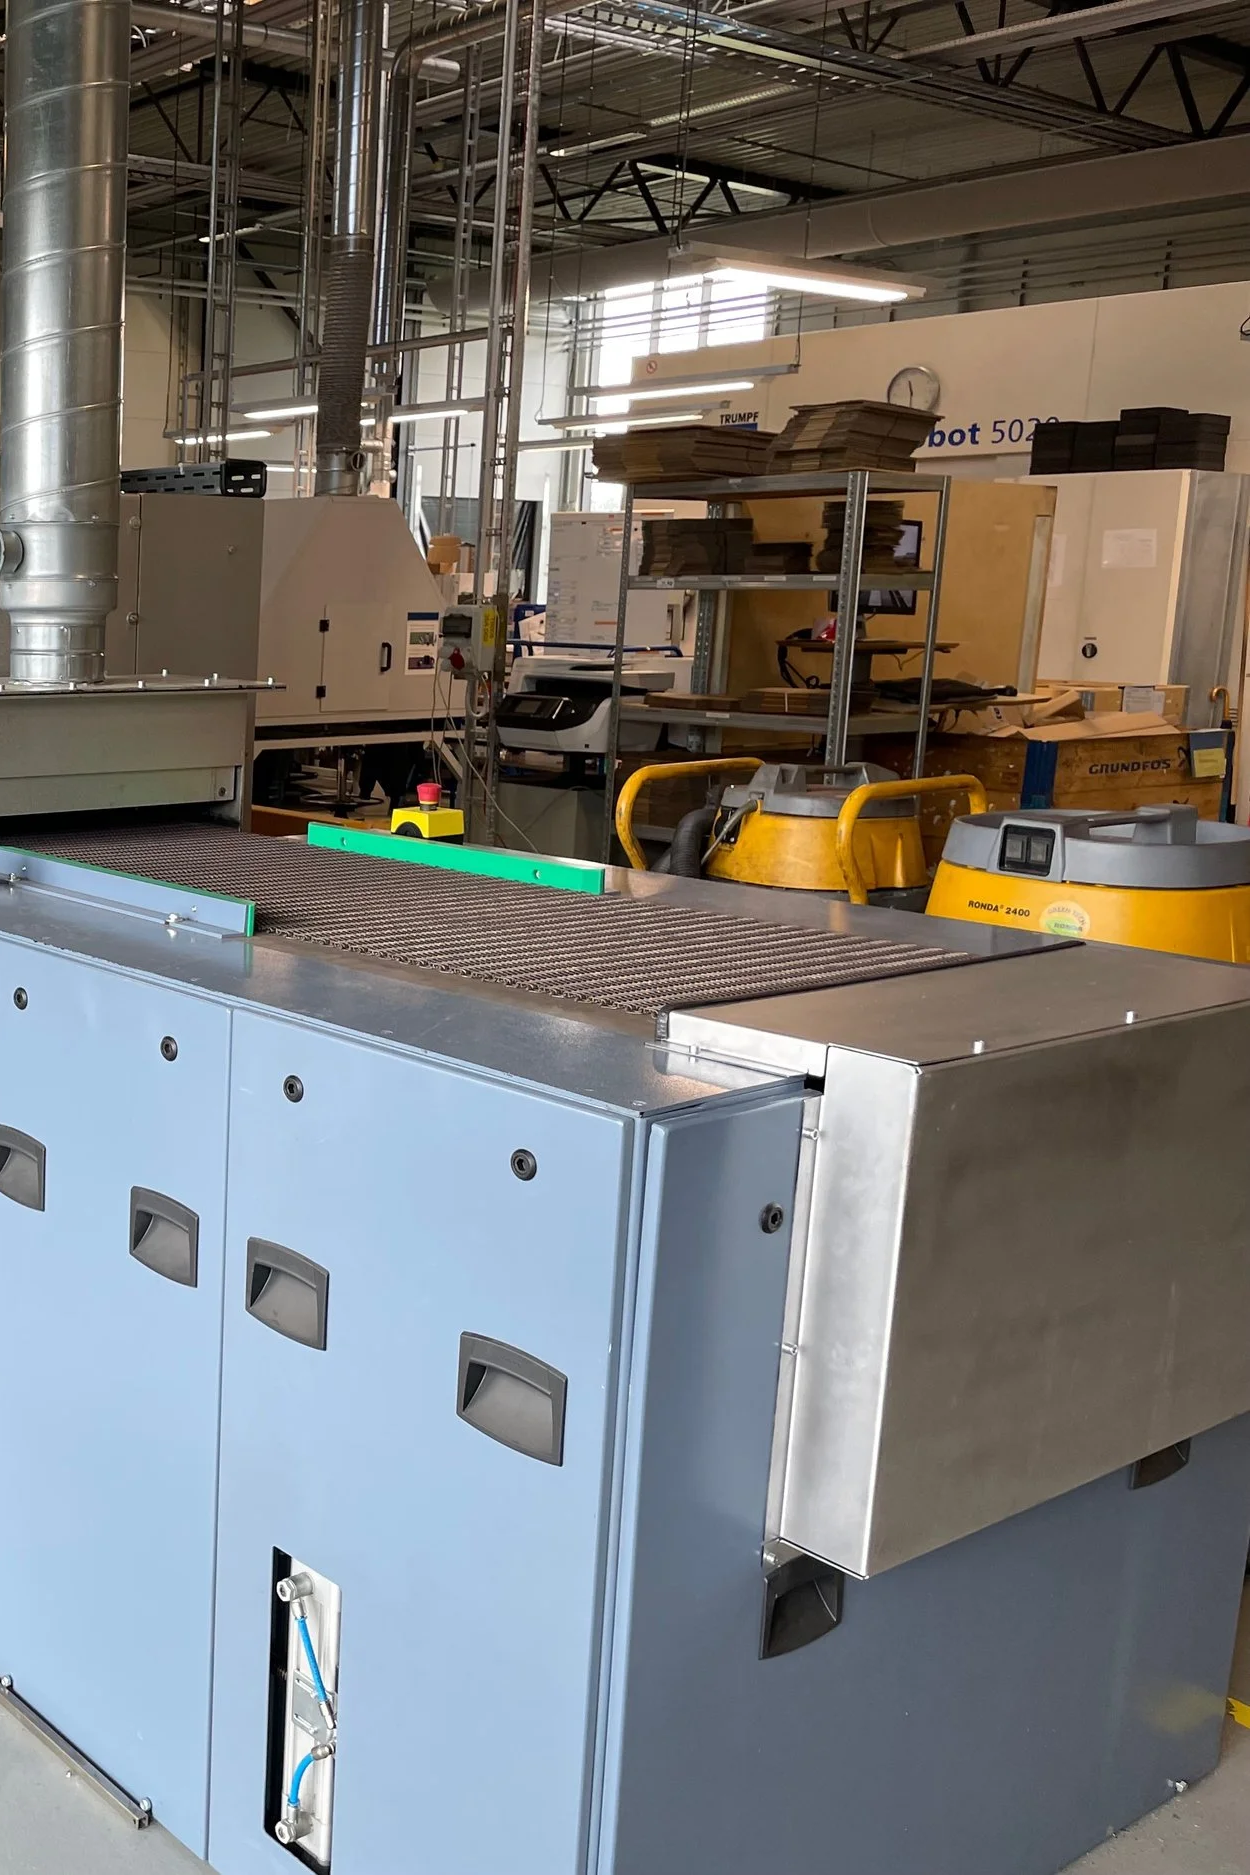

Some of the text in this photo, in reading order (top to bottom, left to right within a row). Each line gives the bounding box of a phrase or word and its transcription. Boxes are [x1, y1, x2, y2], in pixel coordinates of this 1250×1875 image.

[720, 411, 759, 425] TRUMPF
[991, 416, 1060, 444] 502
[1089, 759, 1171, 775] GRUNDFOS
[1005, 907, 1030, 917] 2400
